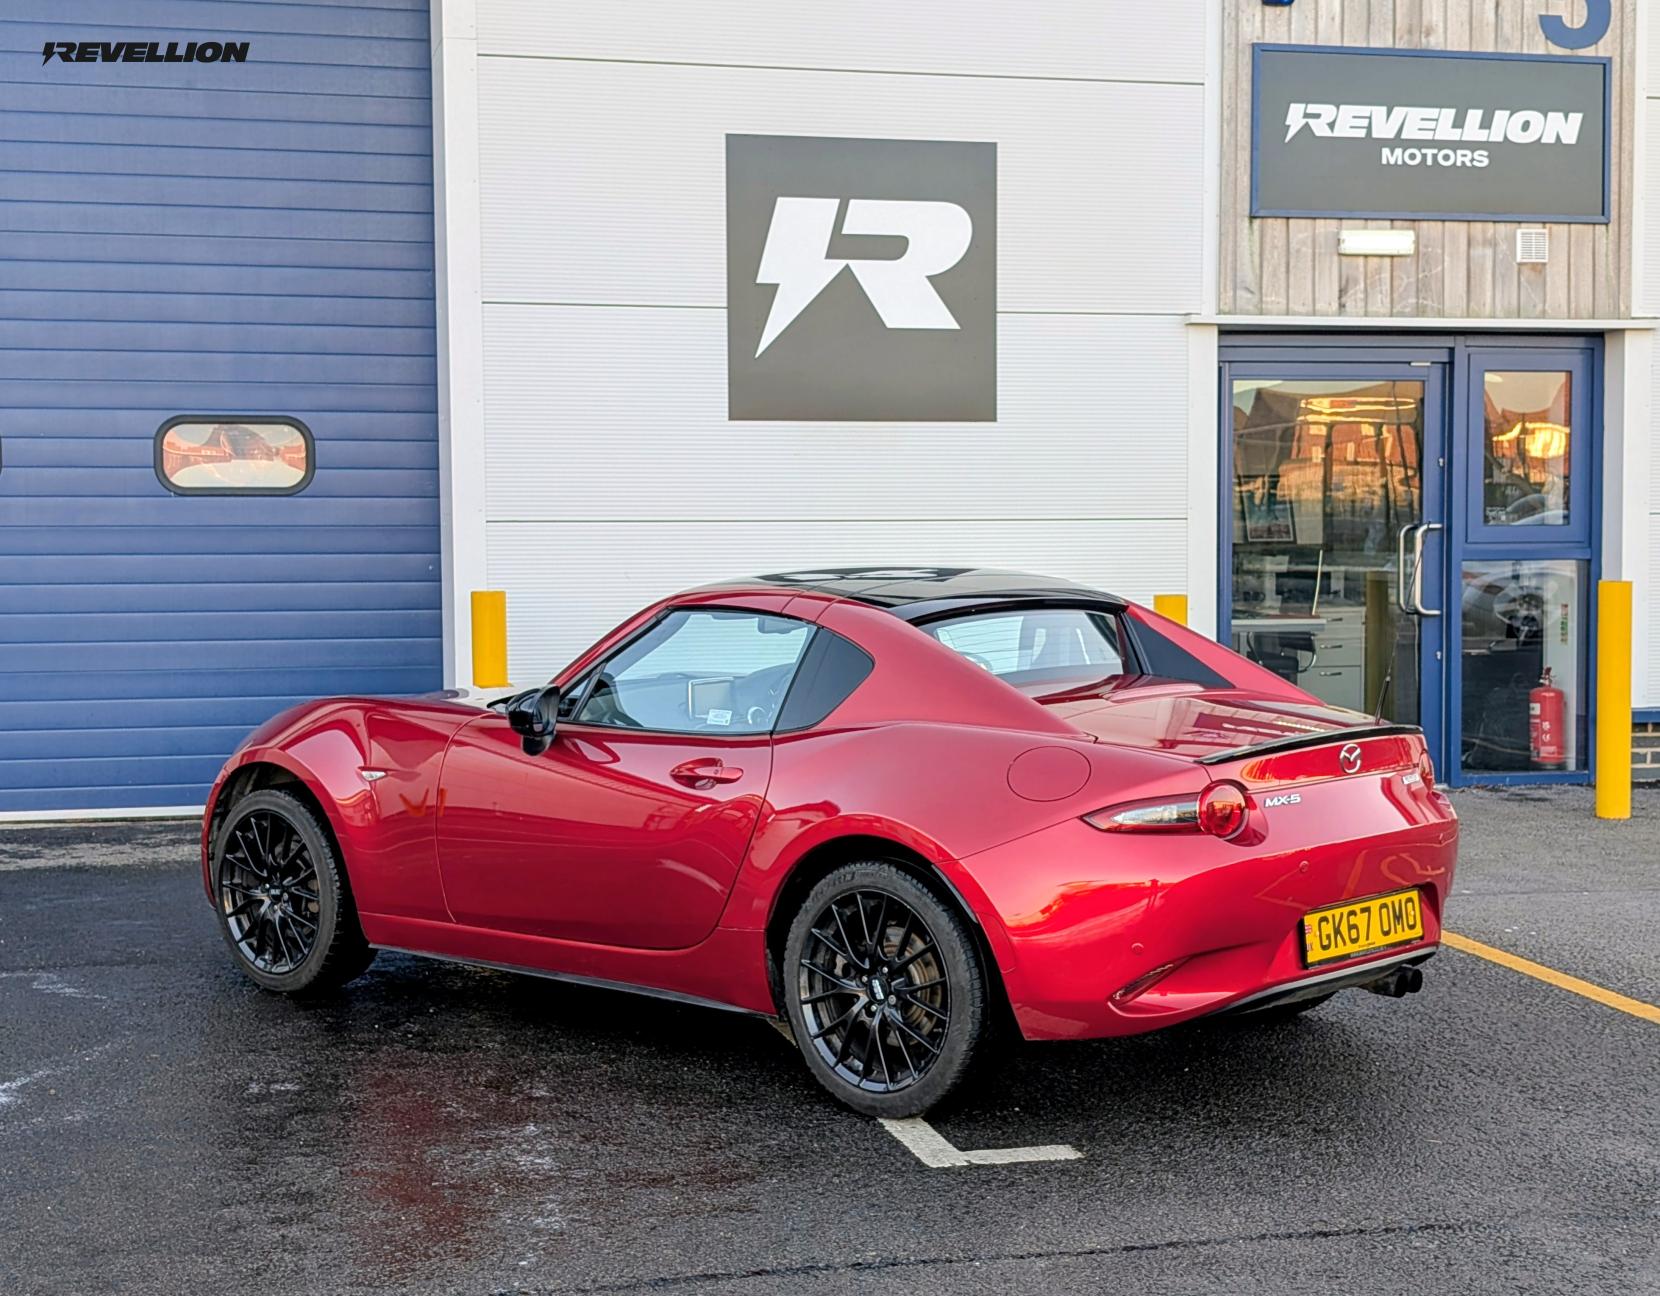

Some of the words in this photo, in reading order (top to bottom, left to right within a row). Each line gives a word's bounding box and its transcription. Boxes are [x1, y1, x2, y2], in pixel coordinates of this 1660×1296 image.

[1285, 103, 1584, 145] REVELLION
[1381, 147, 1490, 168] MOTORS
[754, 196, 973, 360] R
[1264, 793, 1302, 808] MX-5
[1317, 906, 1372, 951] GK67
[1378, 897, 1418, 937] OMO
